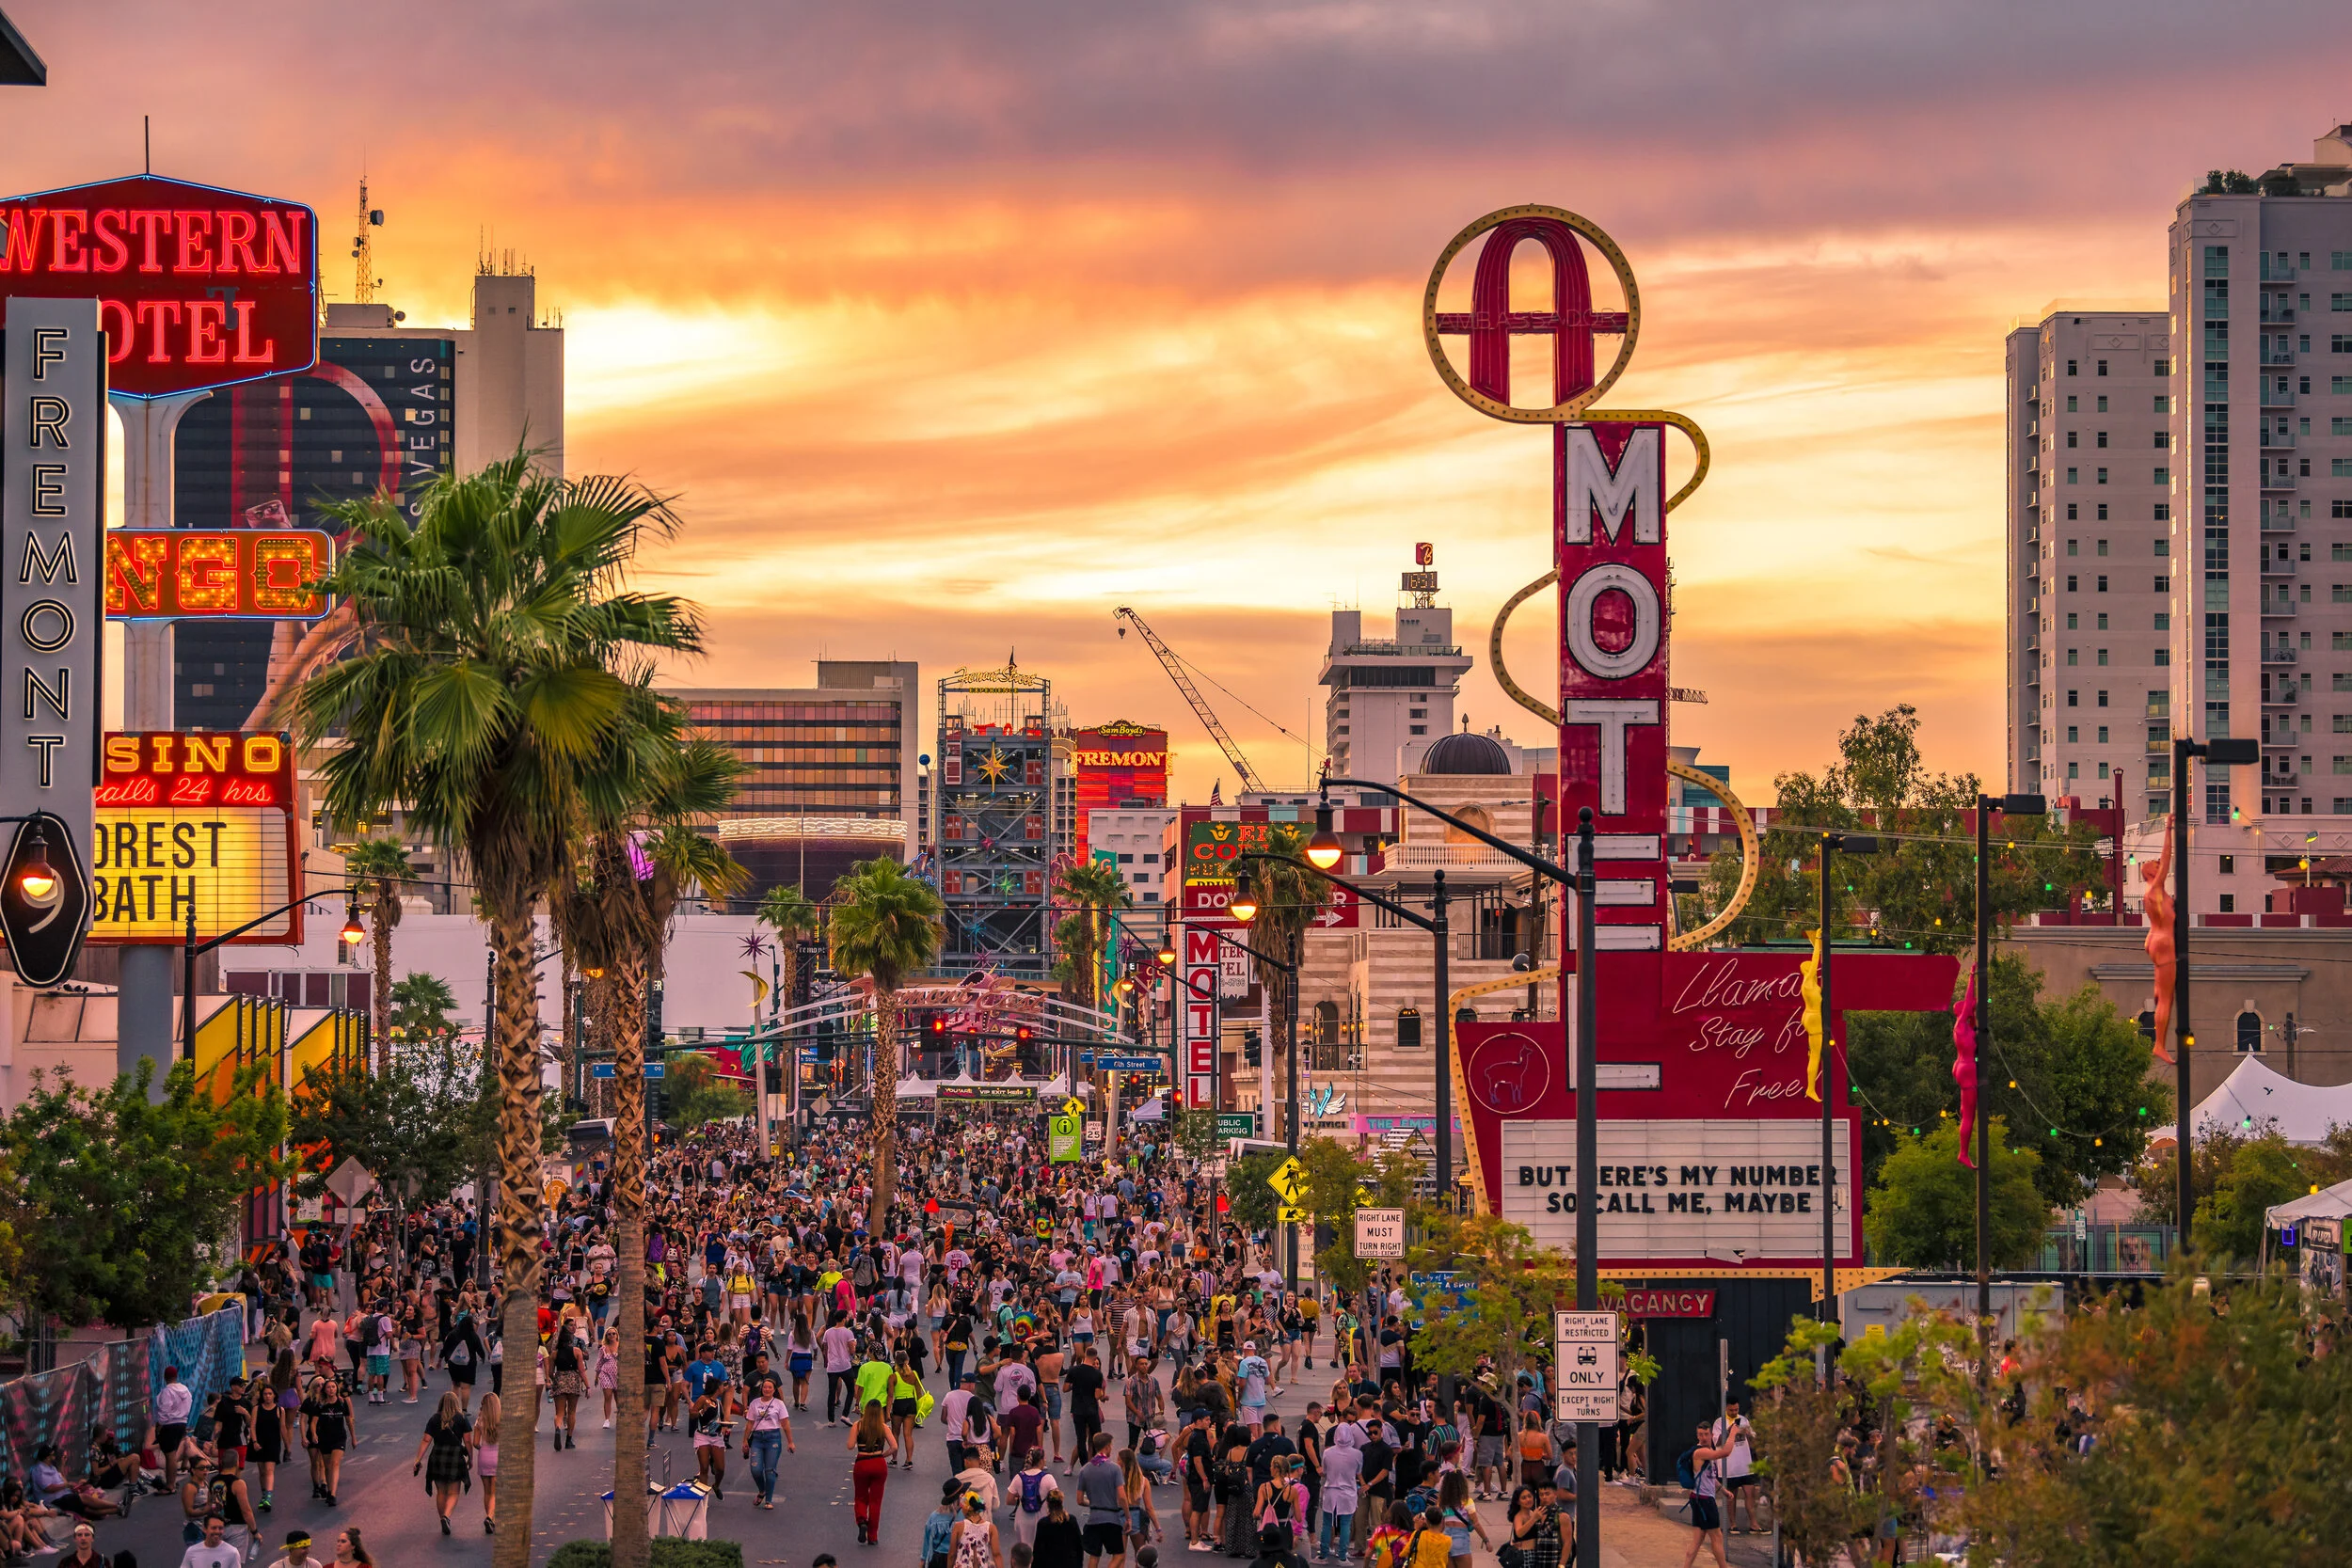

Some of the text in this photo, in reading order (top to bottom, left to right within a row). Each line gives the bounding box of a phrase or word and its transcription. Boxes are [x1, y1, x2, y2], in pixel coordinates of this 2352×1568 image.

[0, 209, 307, 274] WESTERN
[410, 357, 436, 477] VEGAS
[17, 327, 79, 789] FREMONT
[1100, 725, 1144, 736] Sam Boyd's
[106, 736, 280, 772] SINO
[1070, 751, 1179, 776] FREMONT
[1565, 426, 1662, 1092] MOTEL
[171, 777, 210, 801] 24
[1672, 958, 1821, 1014] Llama
[1187, 931, 1219, 1109] MOTEL
[1689, 1006, 1807, 1059] Stay fo
[1126, 1060, 1146, 1069] Street
[1724, 1069, 1822, 1109] Free
[1087, 1131, 1101, 1139] 25
[1367, 1118, 1438, 1130] THE EMPT
[1518, 1165, 1571, 1187] BUT
[1597, 1165, 1669, 1187] ERE'S
[1680, 1165, 1719, 1187] MY
[1546, 1192, 1578, 1213] SO
[1668, 1193, 1712, 1215] ME,
[1724, 1192, 1811, 1213] MAYBE
[1359, 1213, 1401, 1223] RIGHT LANE
[1367, 1227, 1393, 1237] MUST
[1380, 1243, 1402, 1251] RIGHT
[950, 1259, 962, 1270] 50
[1600, 1293, 1708, 1313] VACANCY
[1565, 1329, 1609, 1338] RESTRICTED
[1569, 1371, 1604, 1384] ONLY
